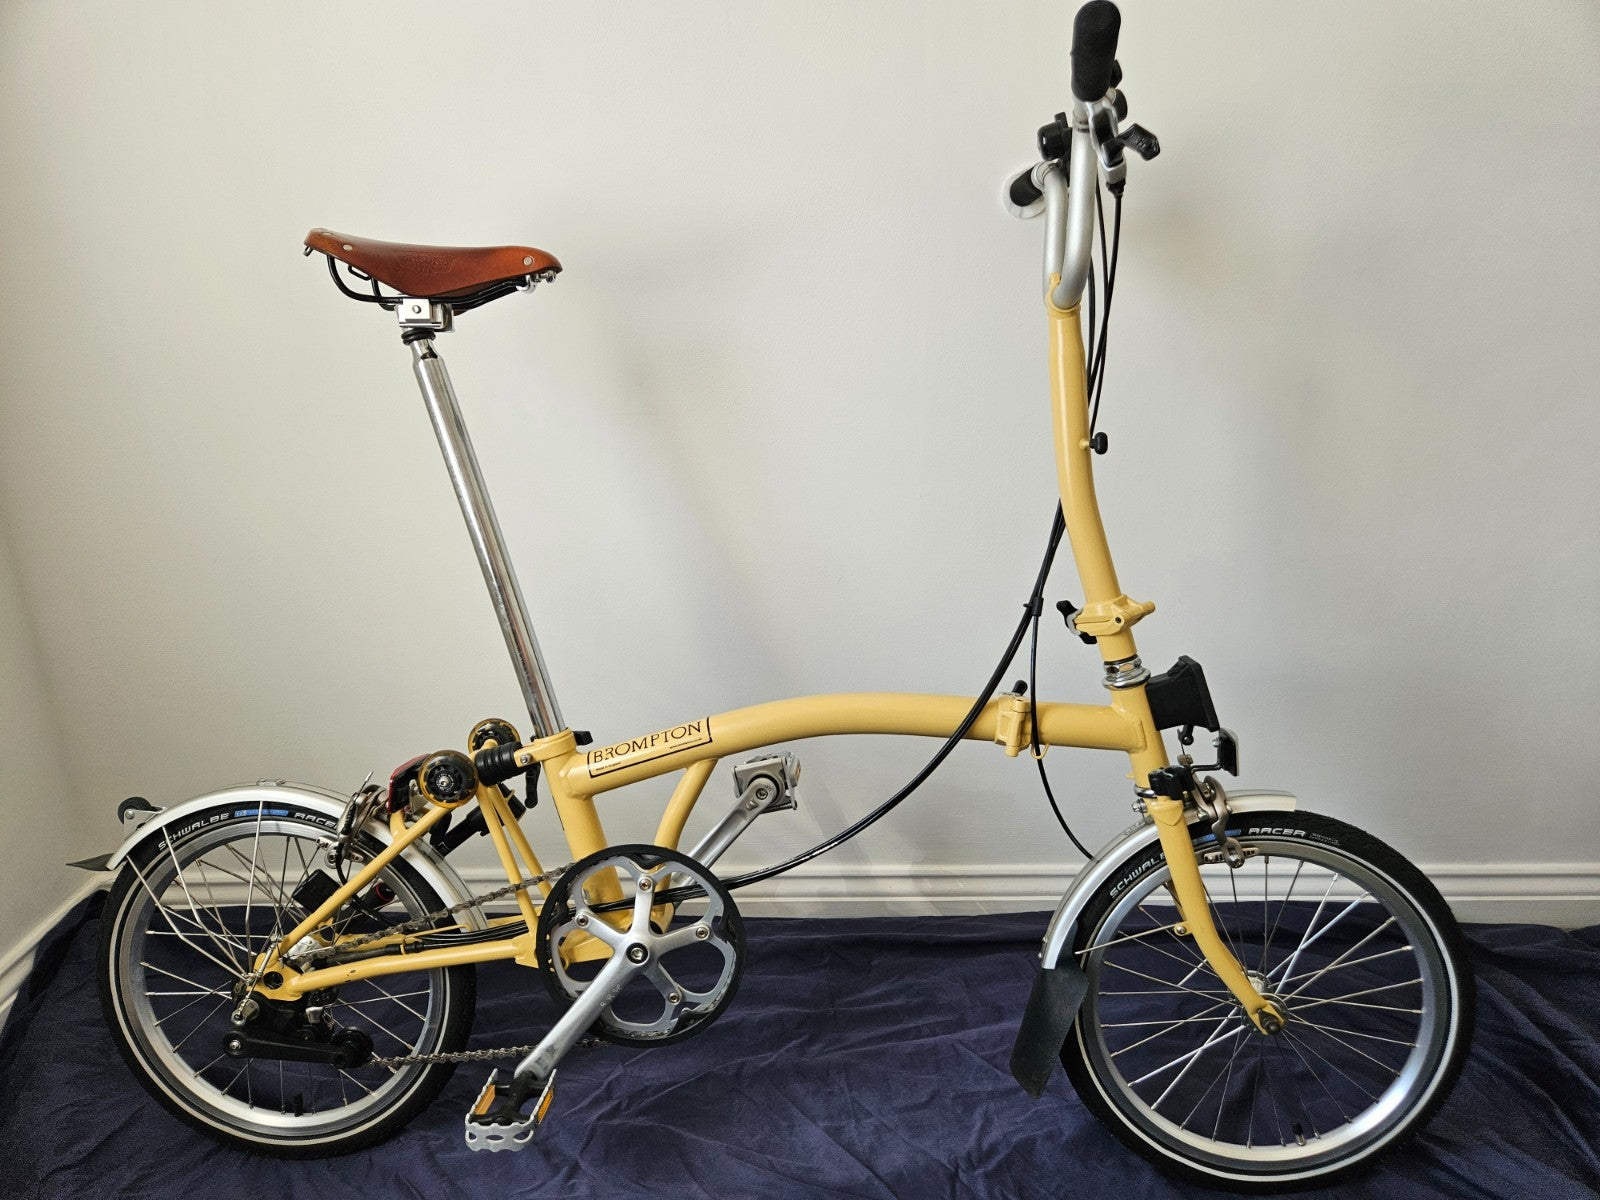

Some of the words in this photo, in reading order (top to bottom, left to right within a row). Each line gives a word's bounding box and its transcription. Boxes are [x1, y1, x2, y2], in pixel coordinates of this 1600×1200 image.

[593, 721, 702, 763] BROMPTON
[158, 812, 230, 851] SCHWALBE
[293, 812, 337, 830] RACE
[1248, 827, 1306, 837] RACER
